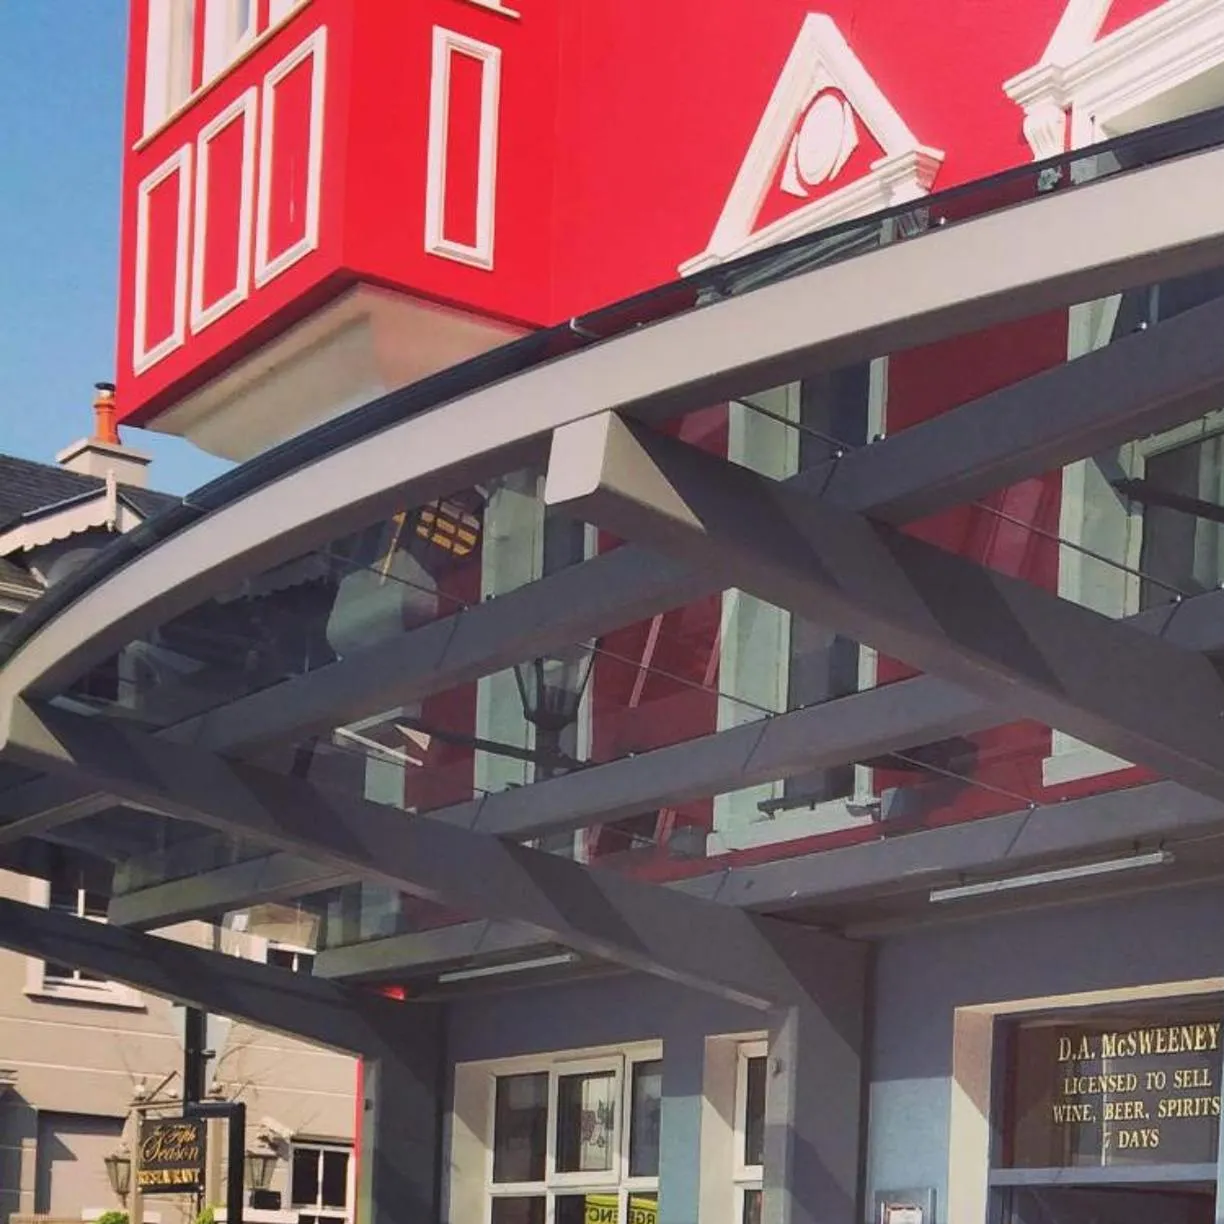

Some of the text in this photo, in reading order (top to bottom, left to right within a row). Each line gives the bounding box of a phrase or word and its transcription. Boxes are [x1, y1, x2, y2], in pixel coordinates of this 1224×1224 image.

[1058, 1023, 1220, 1061] D.A. McSWEENEY
[1064, 1068, 1212, 1095] LICENSED TO SELL
[1158, 1096, 1220, 1118] SPIRITS
[1118, 1129, 1159, 1149] DAYS
